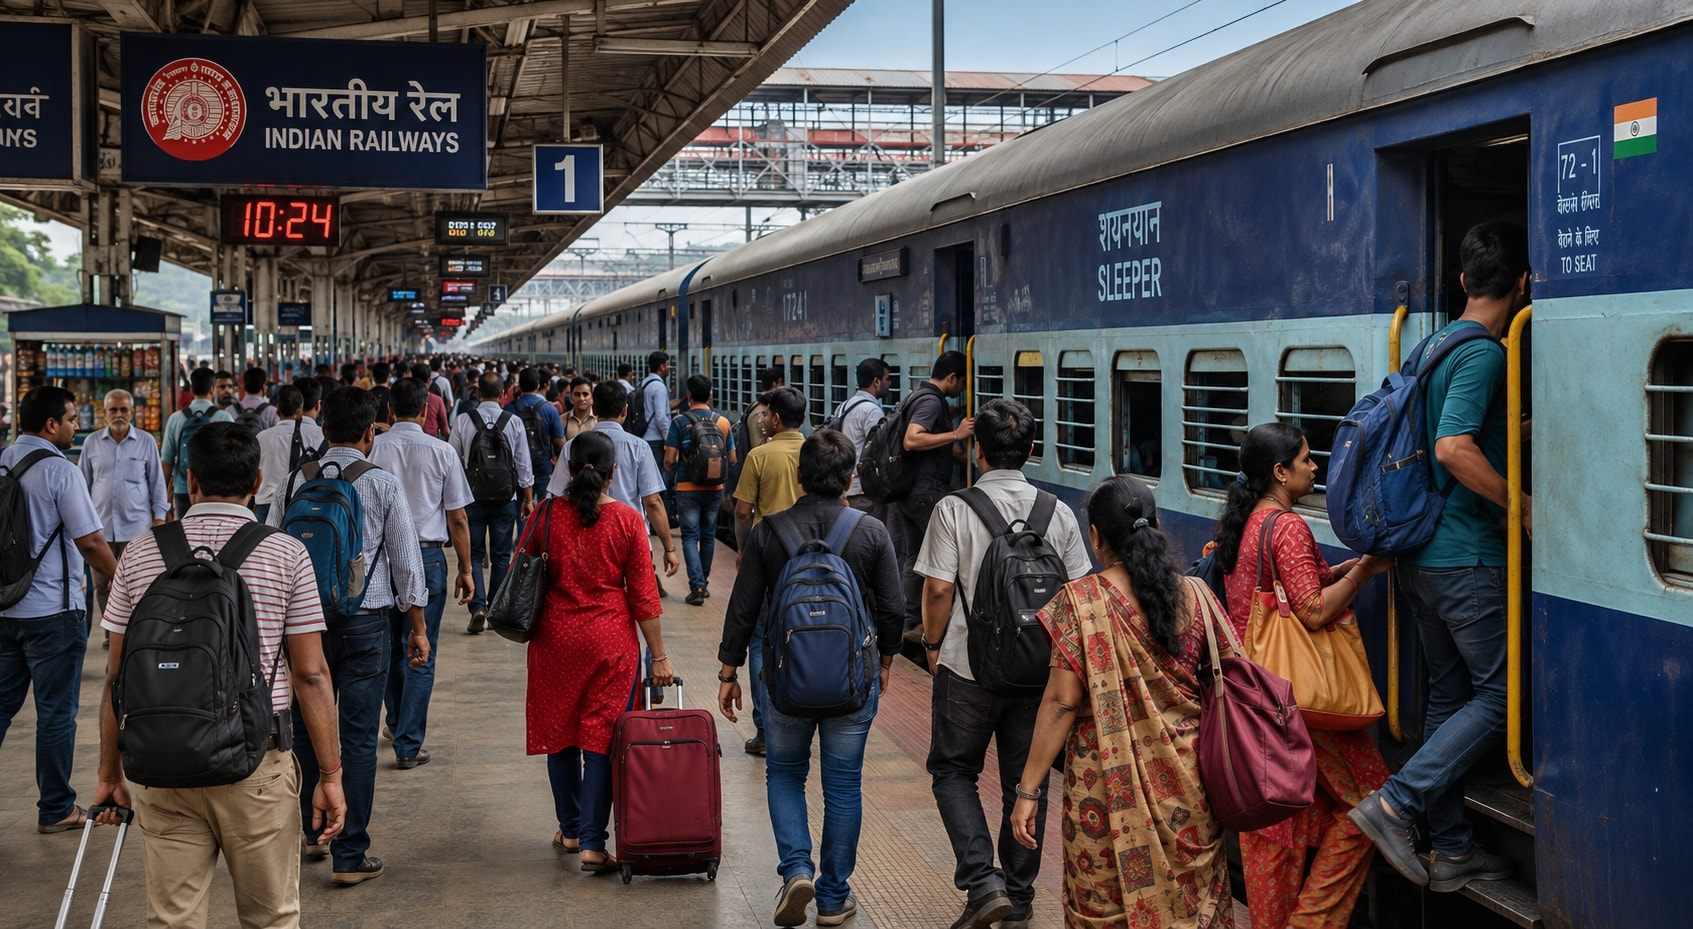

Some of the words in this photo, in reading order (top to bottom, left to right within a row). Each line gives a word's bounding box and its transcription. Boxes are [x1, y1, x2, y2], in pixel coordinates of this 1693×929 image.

[265, 78, 399, 121] भारतीय
[407, 80, 462, 123] रेल
[0, 128, 37, 148] NS
[265, 127, 342, 151] INDIAN
[350, 130, 460, 154] RAILWAYS
[554, 155, 575, 203] 1
[1561, 153, 1576, 180] 72
[1591, 148, 1596, 175] 1
[243, 202, 332, 239] 10:24
[1098, 201, 1162, 251] शयनयान
[1098, 257, 1162, 302] SLEEPER
[1561, 256, 1572, 274] TO
[1574, 253, 1597, 272] SEAT
[783, 289, 807, 322] 17241
